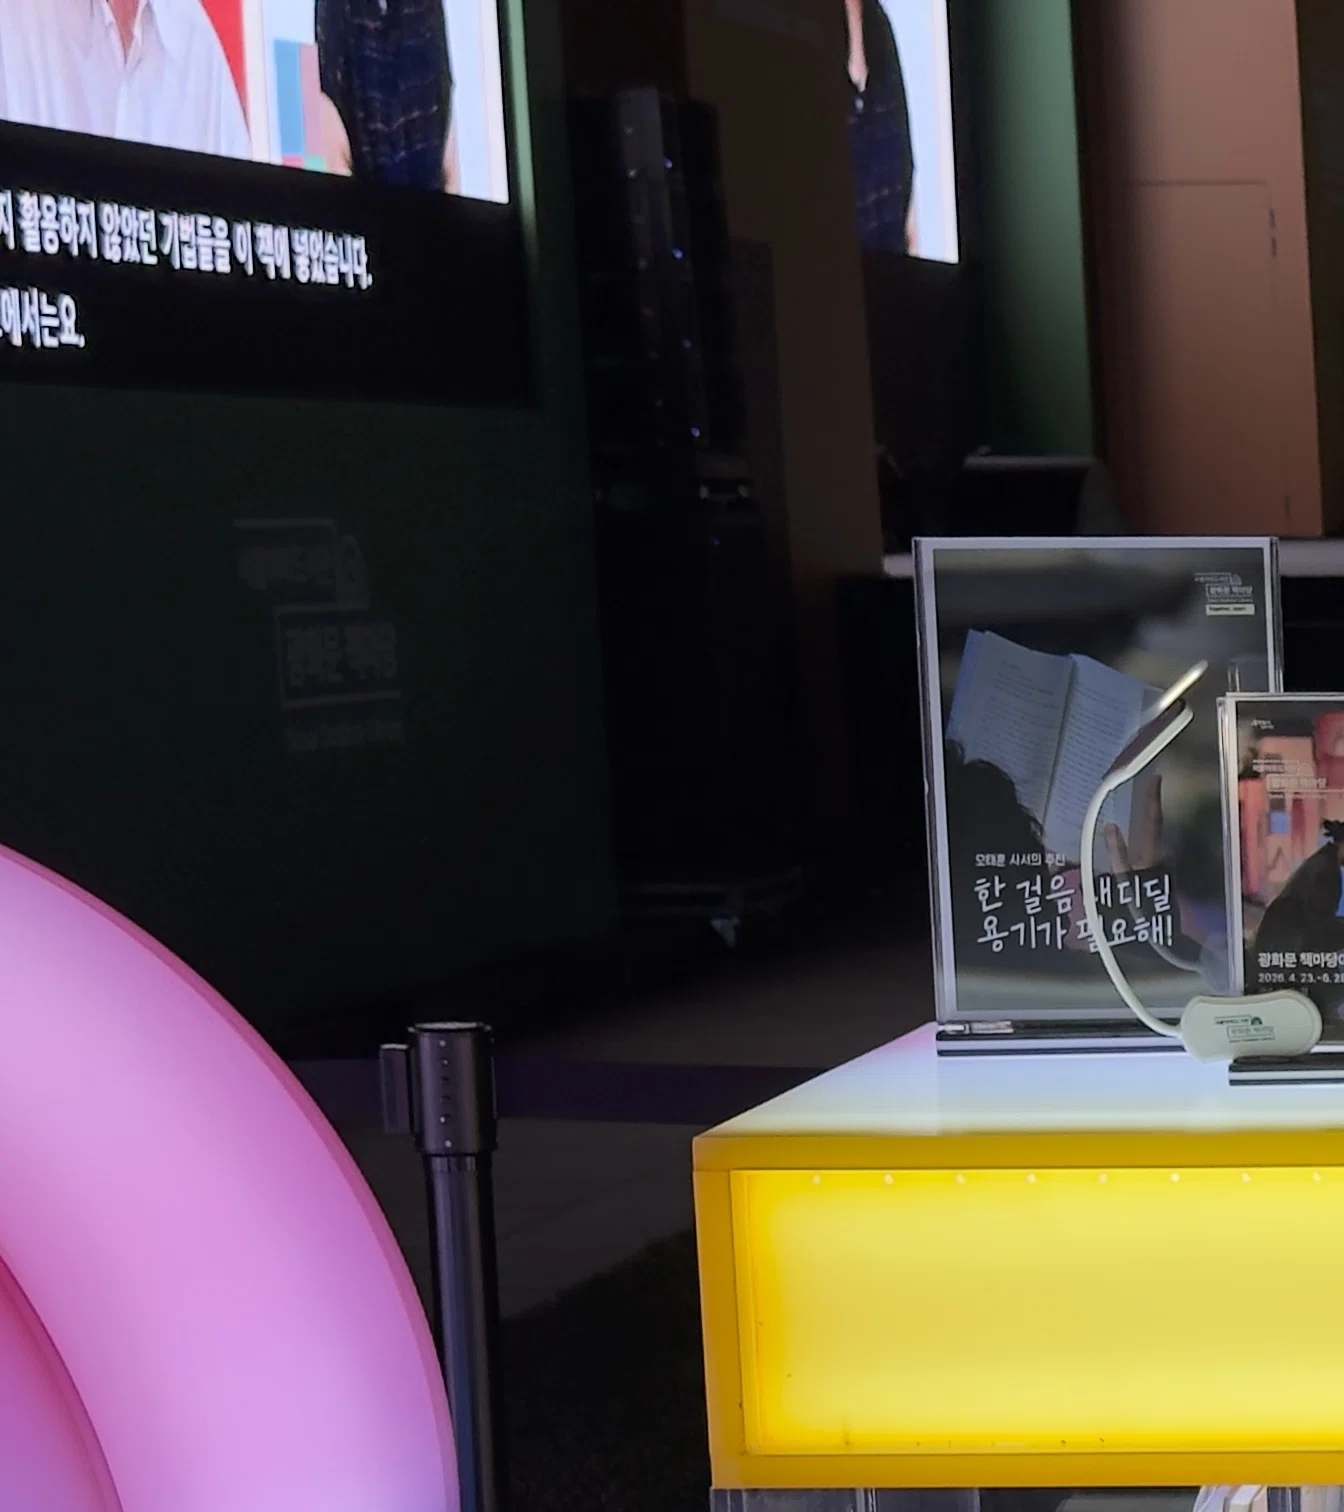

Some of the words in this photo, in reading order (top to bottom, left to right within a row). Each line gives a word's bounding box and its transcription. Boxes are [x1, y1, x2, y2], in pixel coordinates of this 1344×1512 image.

[18, 190, 98, 259] 활용하지
[101, 201, 159, 265] 않았던
[160, 211, 232, 274] 기법들을
[232, 220, 254, 276] 이
[255, 221, 291, 280] 책에
[290, 227, 374, 290] 넣었습니다.
[1008, 852, 1042, 866] 사서의
[974, 874, 1007, 913] 한
[1015, 873, 1076, 915] 걸음
[976, 914, 1068, 953] 용기가
[1075, 913, 1174, 954] 필요해!
[1257, 952, 1298, 968] 광화문
